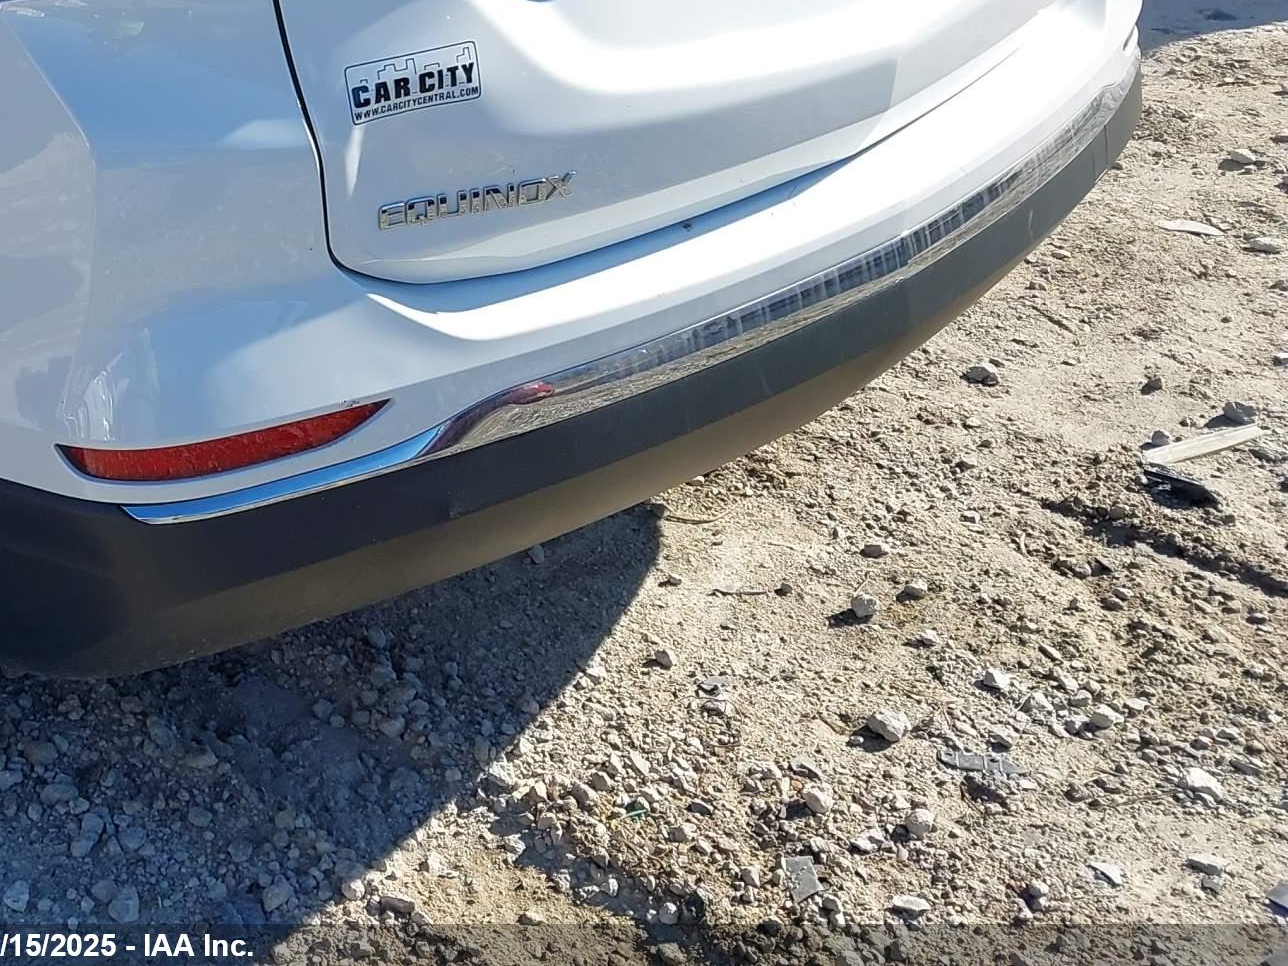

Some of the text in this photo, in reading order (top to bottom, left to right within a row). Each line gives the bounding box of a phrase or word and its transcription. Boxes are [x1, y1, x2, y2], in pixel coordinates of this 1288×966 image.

[351, 61, 475, 109] CAR CITY
[354, 86, 479, 121] WWW.CARCITYCENTRAL.COM
[377, 170, 577, 231] EQUINOX
